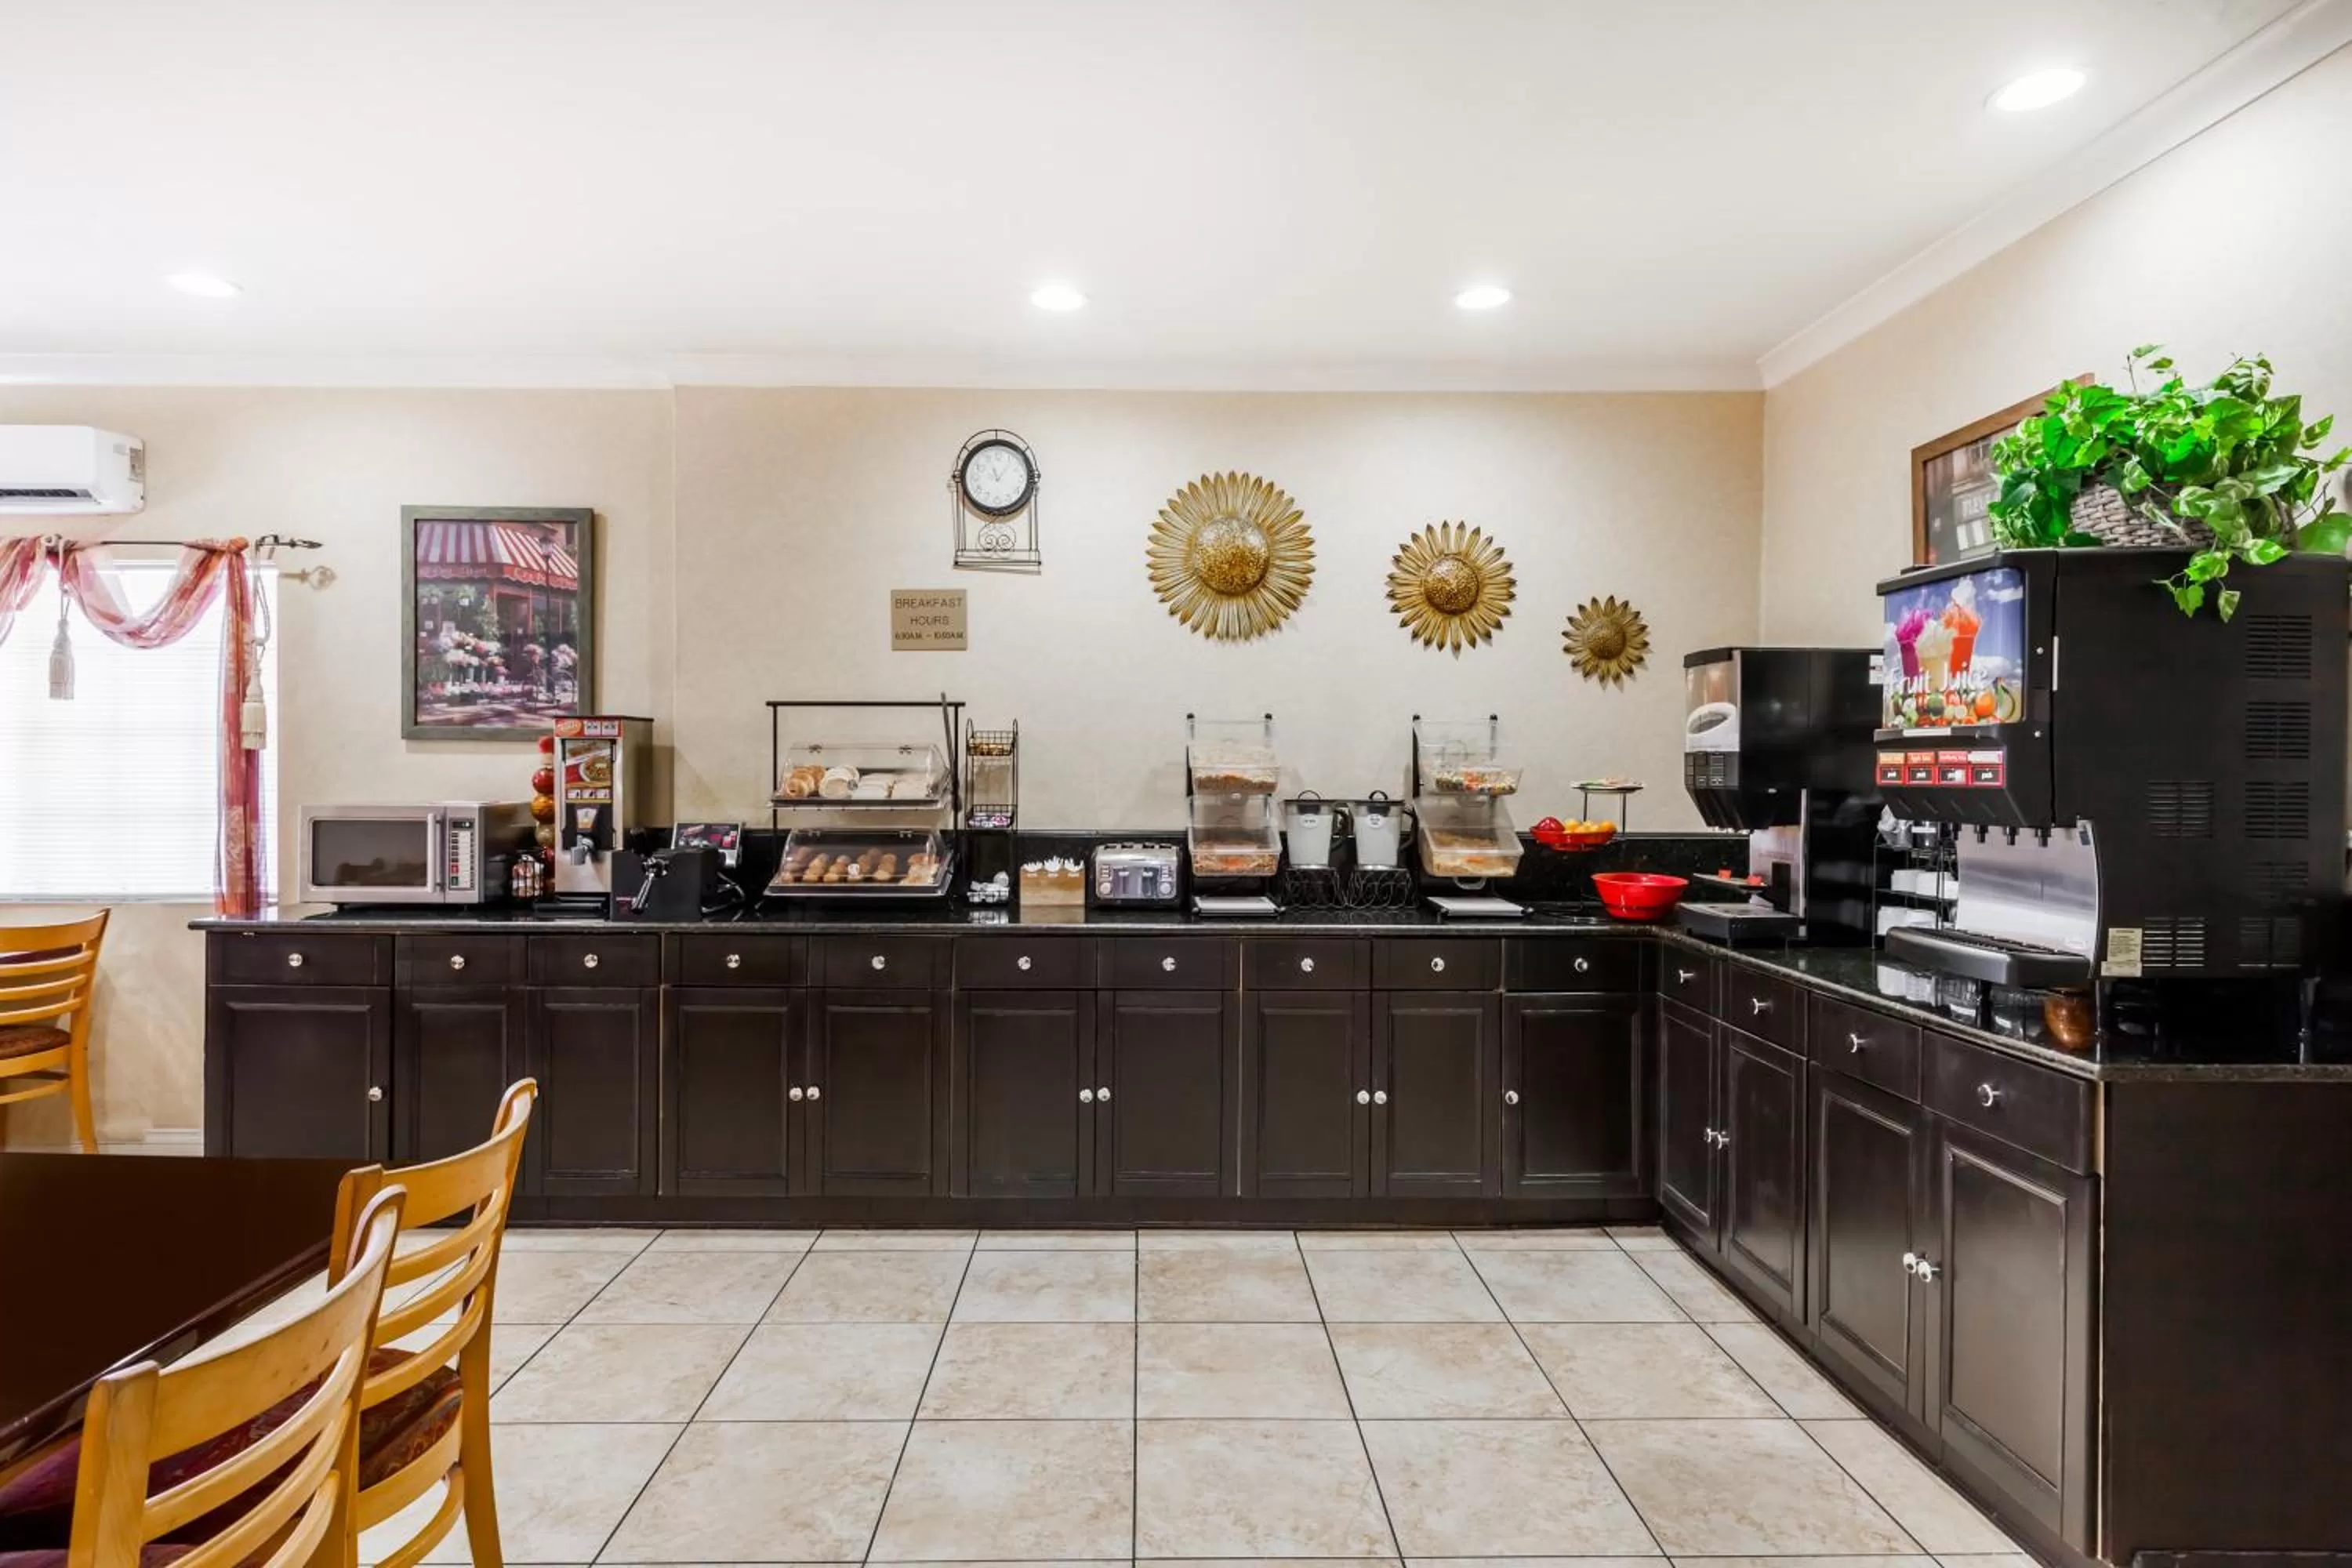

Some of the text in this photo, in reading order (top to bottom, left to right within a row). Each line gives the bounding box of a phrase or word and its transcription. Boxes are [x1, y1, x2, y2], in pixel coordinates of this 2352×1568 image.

[895, 598, 963, 608] BREAKFAST
[909, 615, 950, 626] HOURS
[1890, 661, 1987, 695] Fruit Juice
